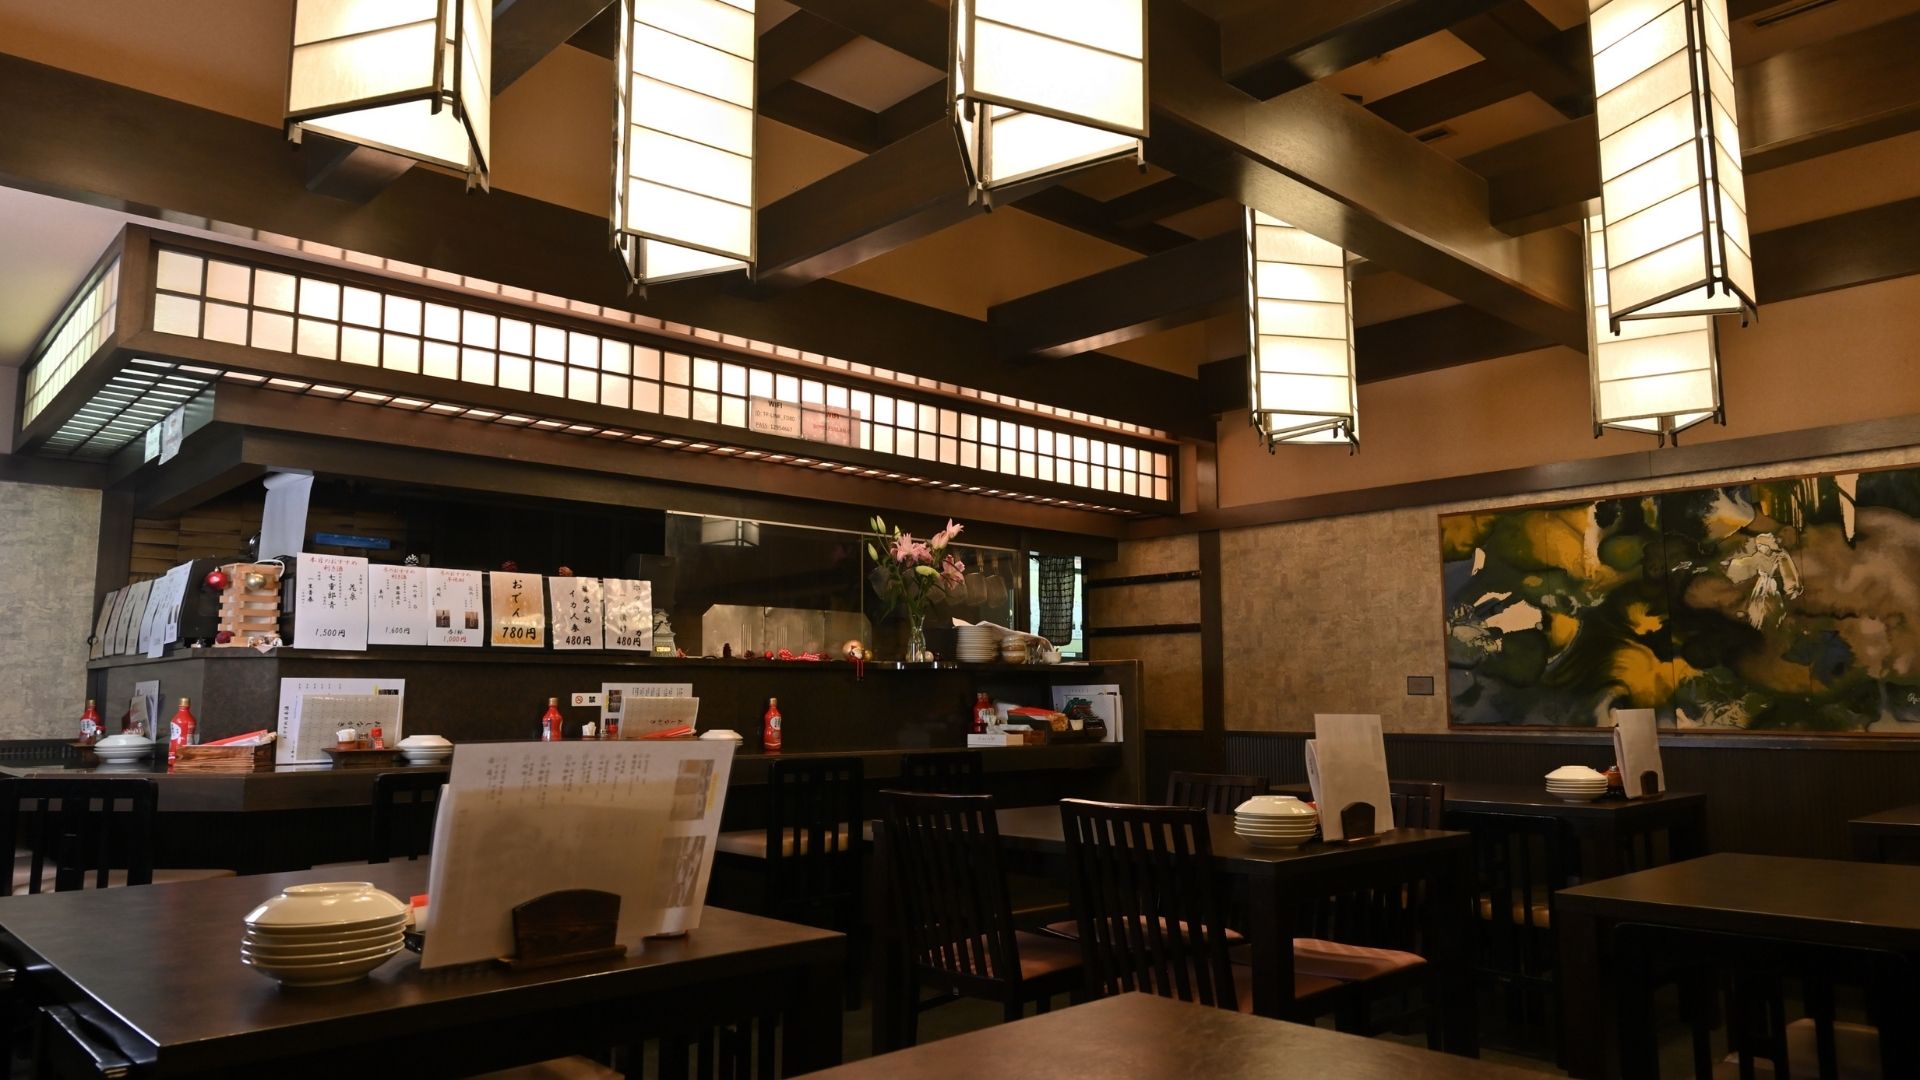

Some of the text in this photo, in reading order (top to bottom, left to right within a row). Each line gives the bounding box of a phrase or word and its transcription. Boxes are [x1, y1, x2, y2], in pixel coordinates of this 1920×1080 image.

[768, 400, 783, 409] WIFI
[512, 579, 523, 618] おでん
[569, 589, 580, 632] イカ人参
[314, 628, 346, 638] 1,500円
[384, 626, 411, 636] 1,600円
[502, 626, 537, 641] 780円
[565, 635, 592, 646] 480円
[616, 636, 641, 648] 480円
